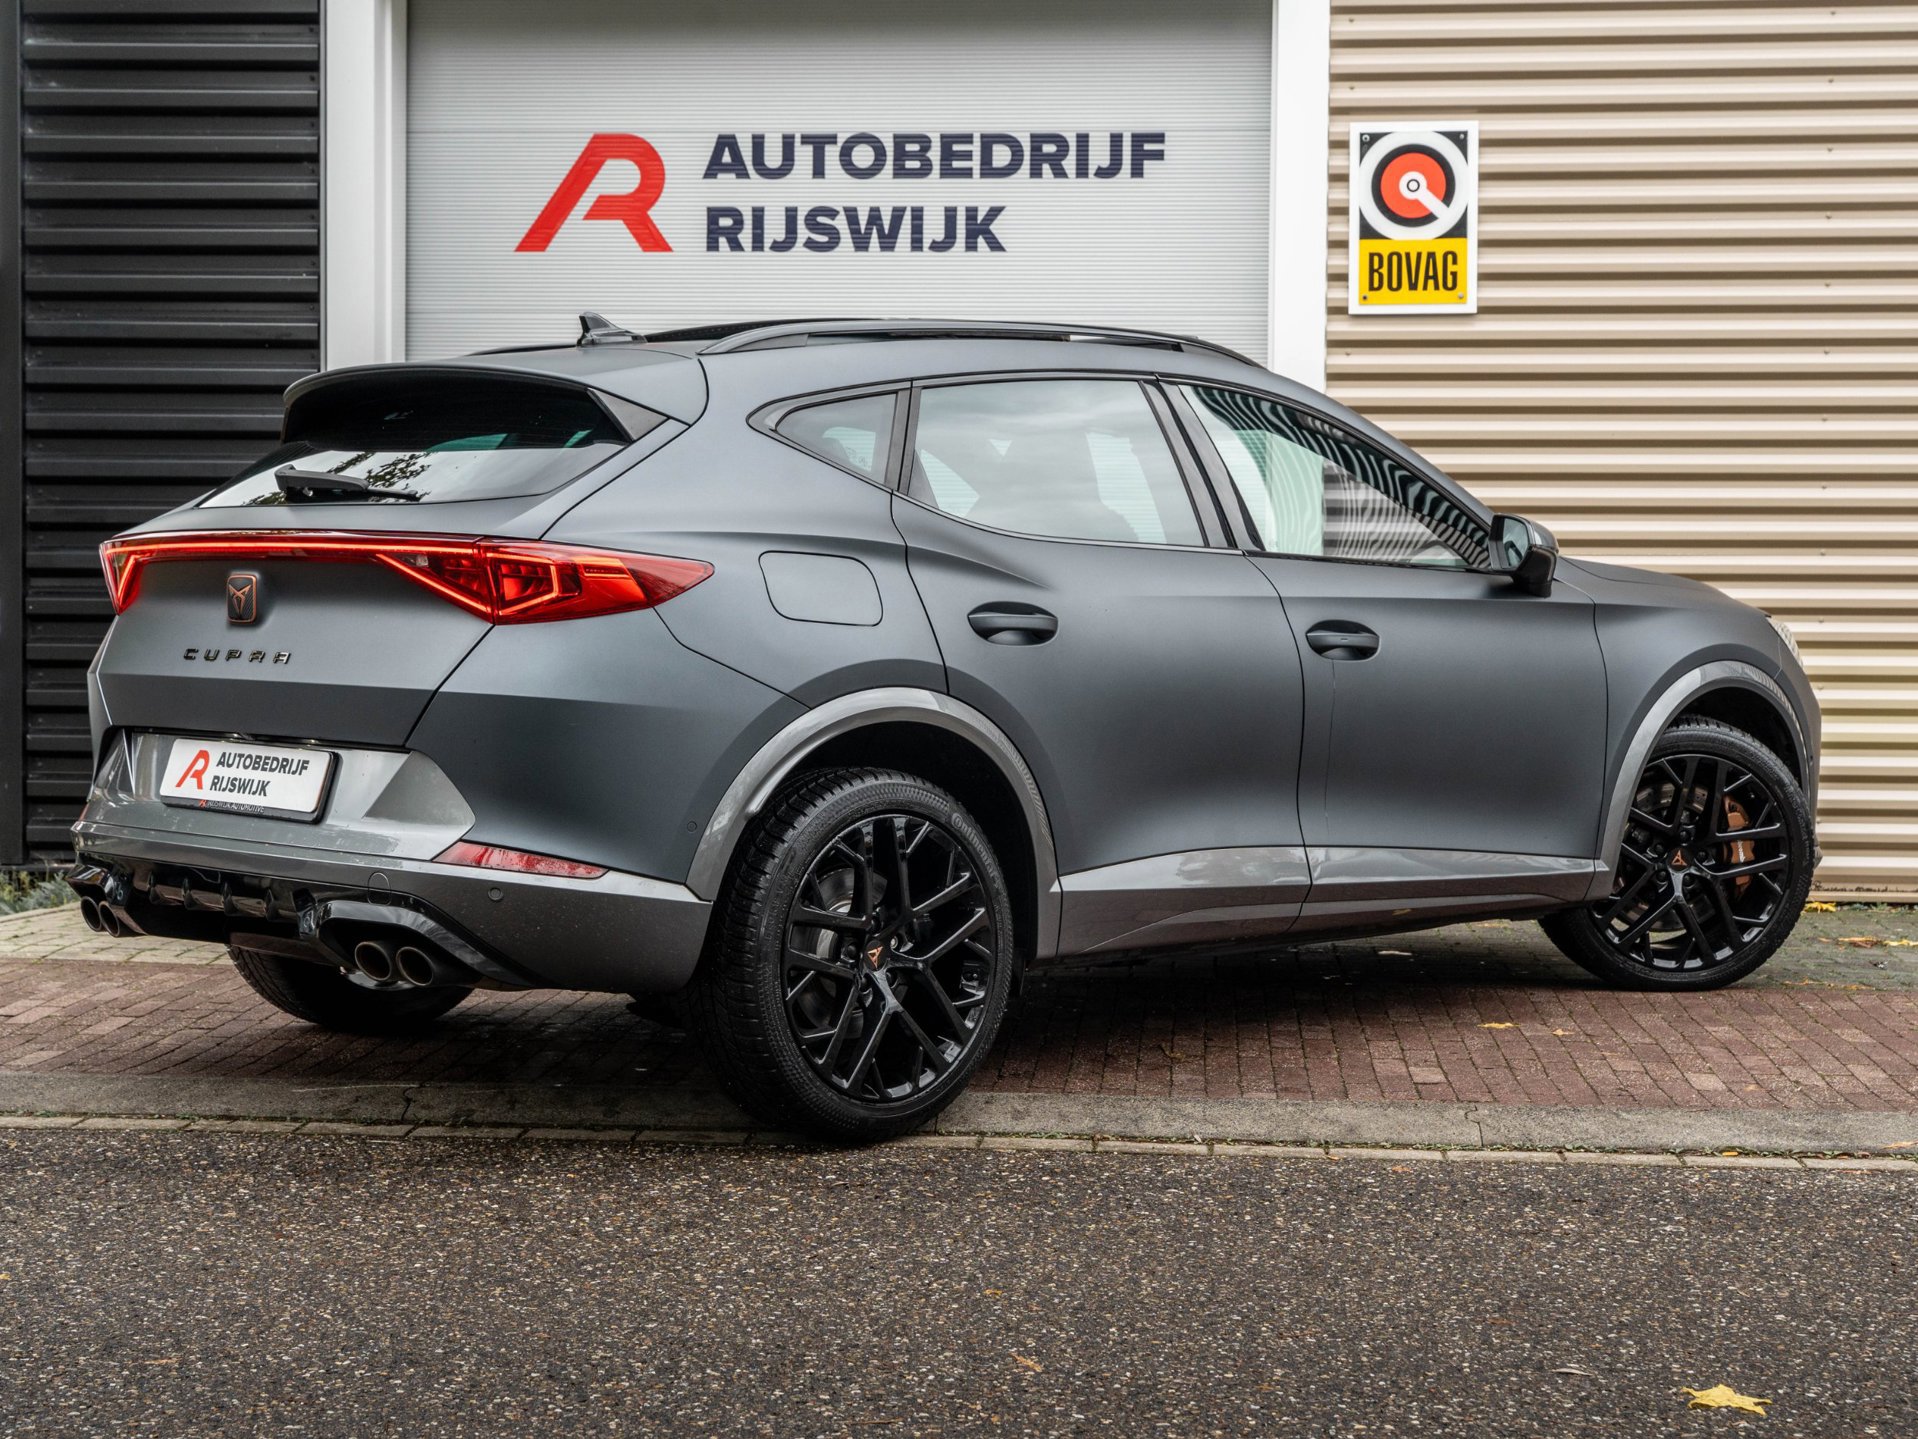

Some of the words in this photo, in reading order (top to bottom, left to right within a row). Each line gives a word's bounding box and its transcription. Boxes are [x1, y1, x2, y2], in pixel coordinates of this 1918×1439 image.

[702, 131, 1166, 180] AUTOBEDRIJF
[705, 205, 1007, 253] RIJSWIJK
[1368, 250, 1458, 292] BOVAG
[183, 648, 291, 665] CUPRA
[216, 751, 310, 776] AUTOBEDRIJF
[209, 775, 271, 797] RIJSWIJK
